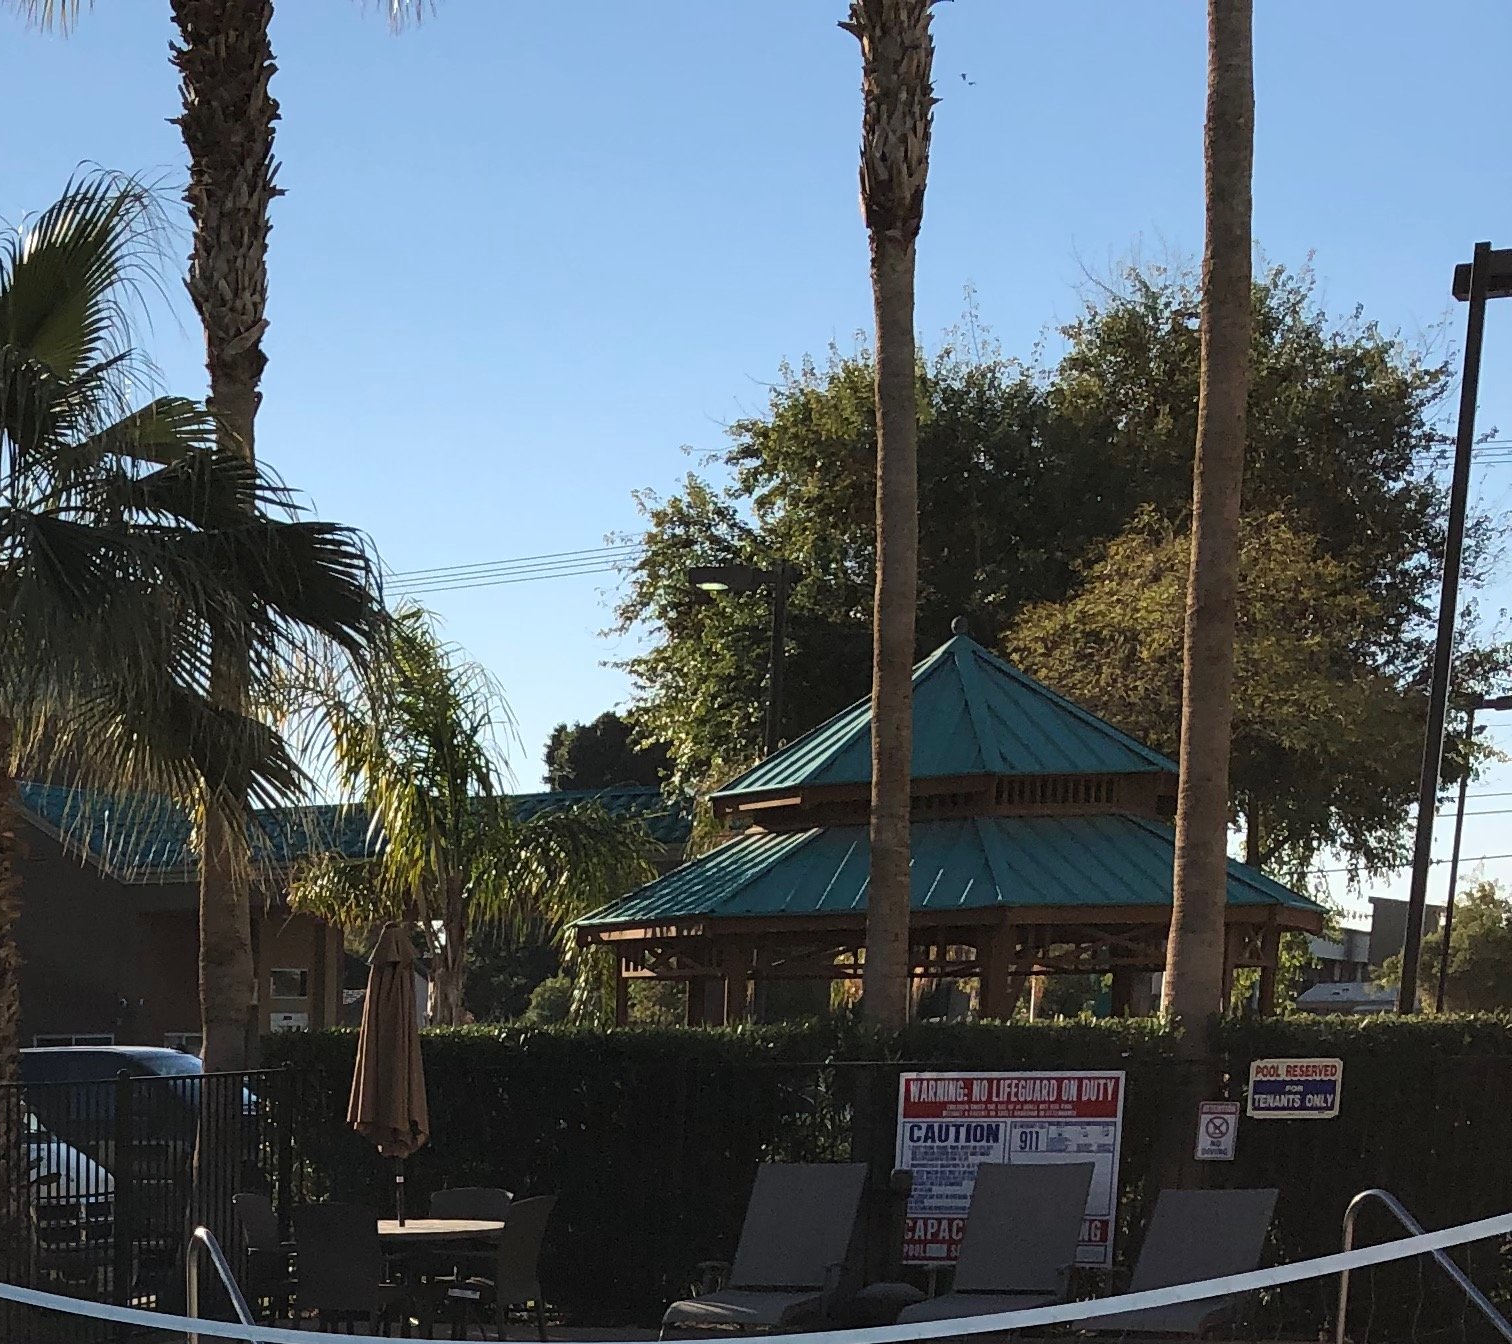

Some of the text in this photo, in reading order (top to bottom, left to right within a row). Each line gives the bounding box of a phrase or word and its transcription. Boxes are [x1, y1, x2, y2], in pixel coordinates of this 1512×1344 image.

[1255, 1064, 1338, 1078] POOL RESERVED
[910, 1078, 1115, 1102] WARNING: NO LIFEGUARD ON DUTY
[1254, 1093, 1334, 1108] TENANTS ONLY
[908, 1123, 1001, 1143] CAUTION
[1018, 1130, 1040, 1150] 911
